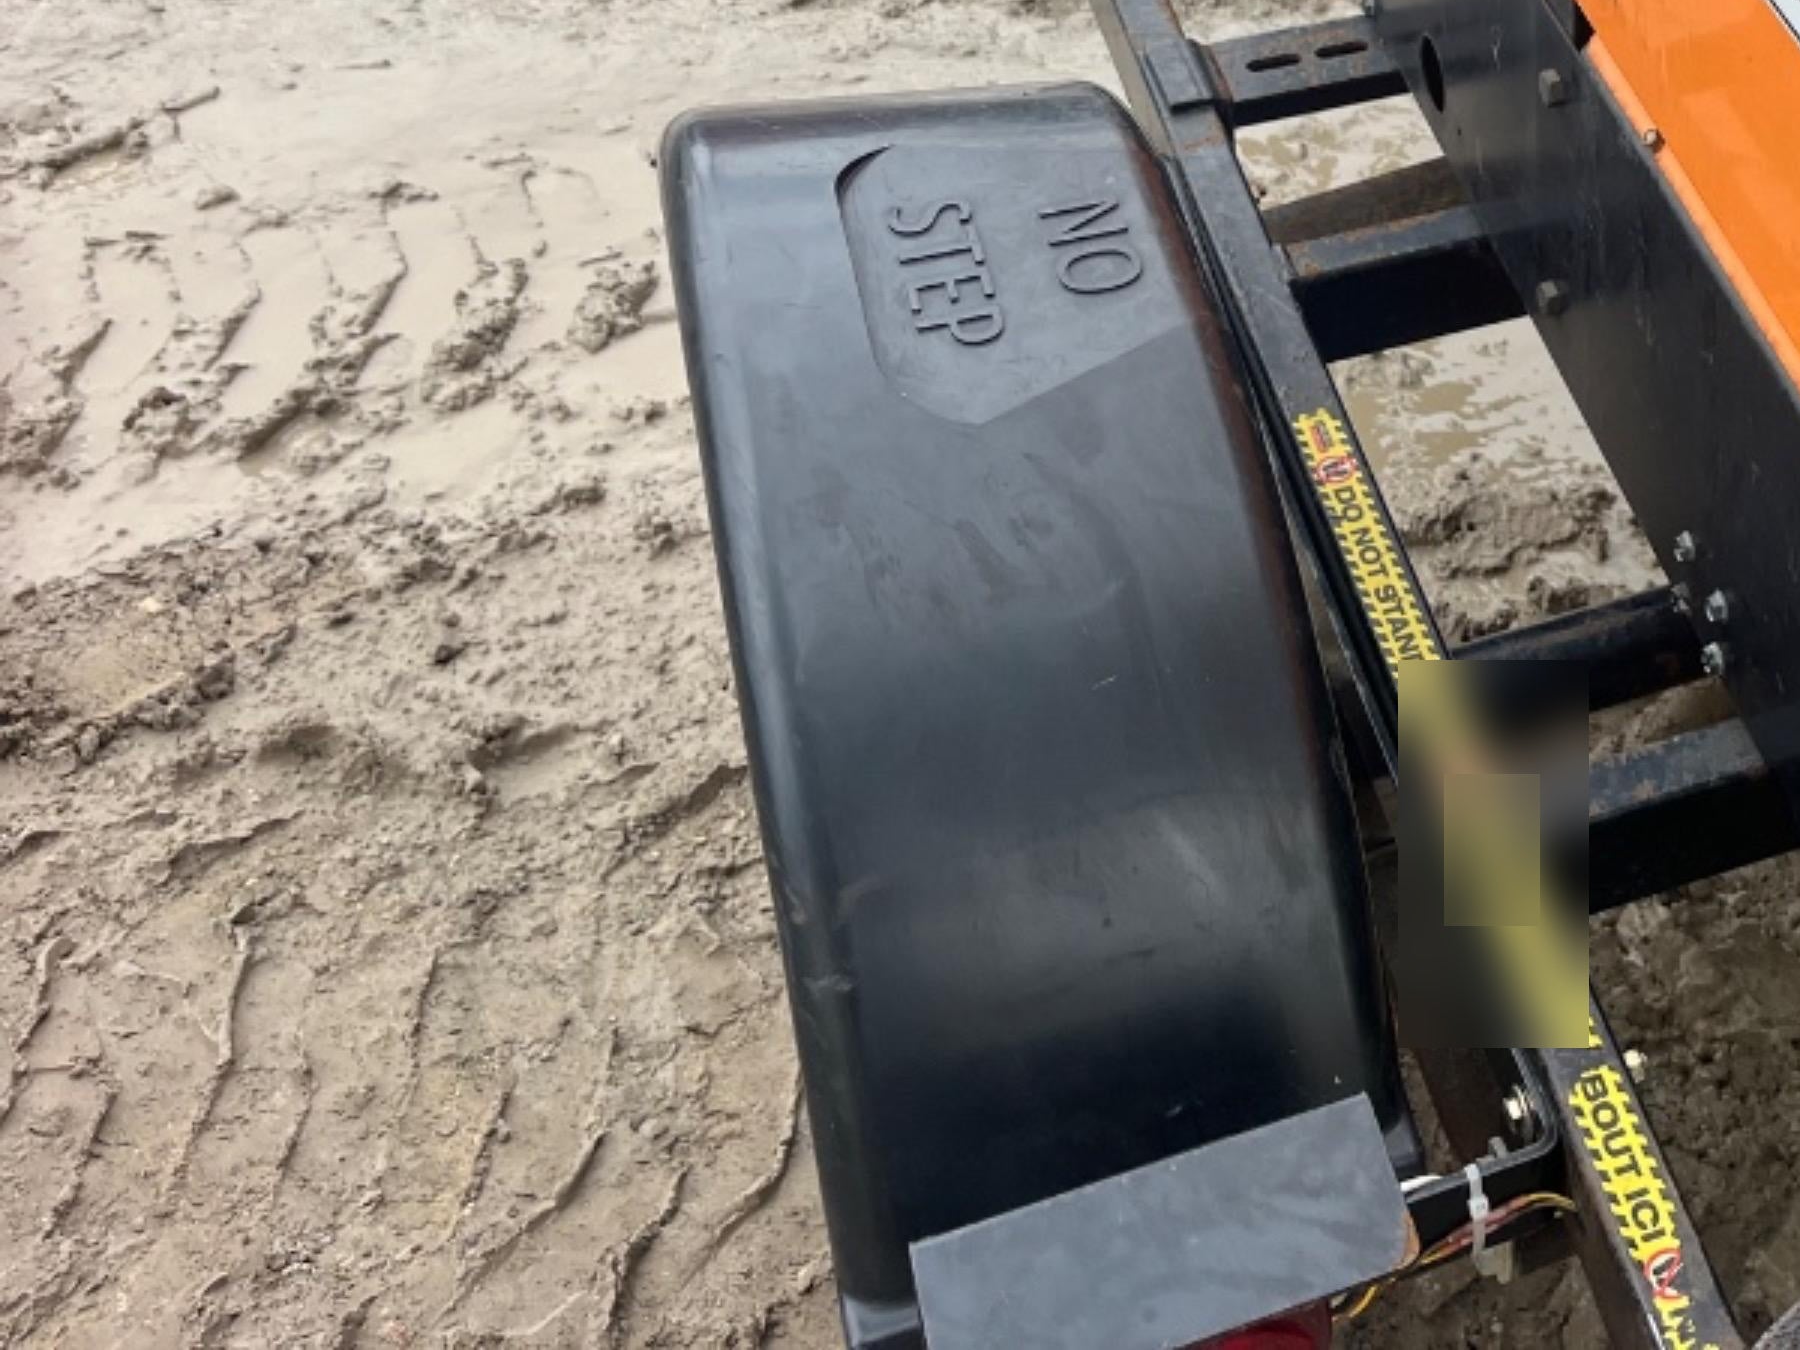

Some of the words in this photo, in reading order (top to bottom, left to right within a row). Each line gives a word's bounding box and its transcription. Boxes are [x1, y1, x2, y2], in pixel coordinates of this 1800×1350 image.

[887, 199, 1007, 347] STEP
[1037, 196, 1144, 296] NO
[1334, 486, 1363, 523] DO
[1350, 526, 1390, 578] NOT
[1623, 1186, 1668, 1244] ICI
